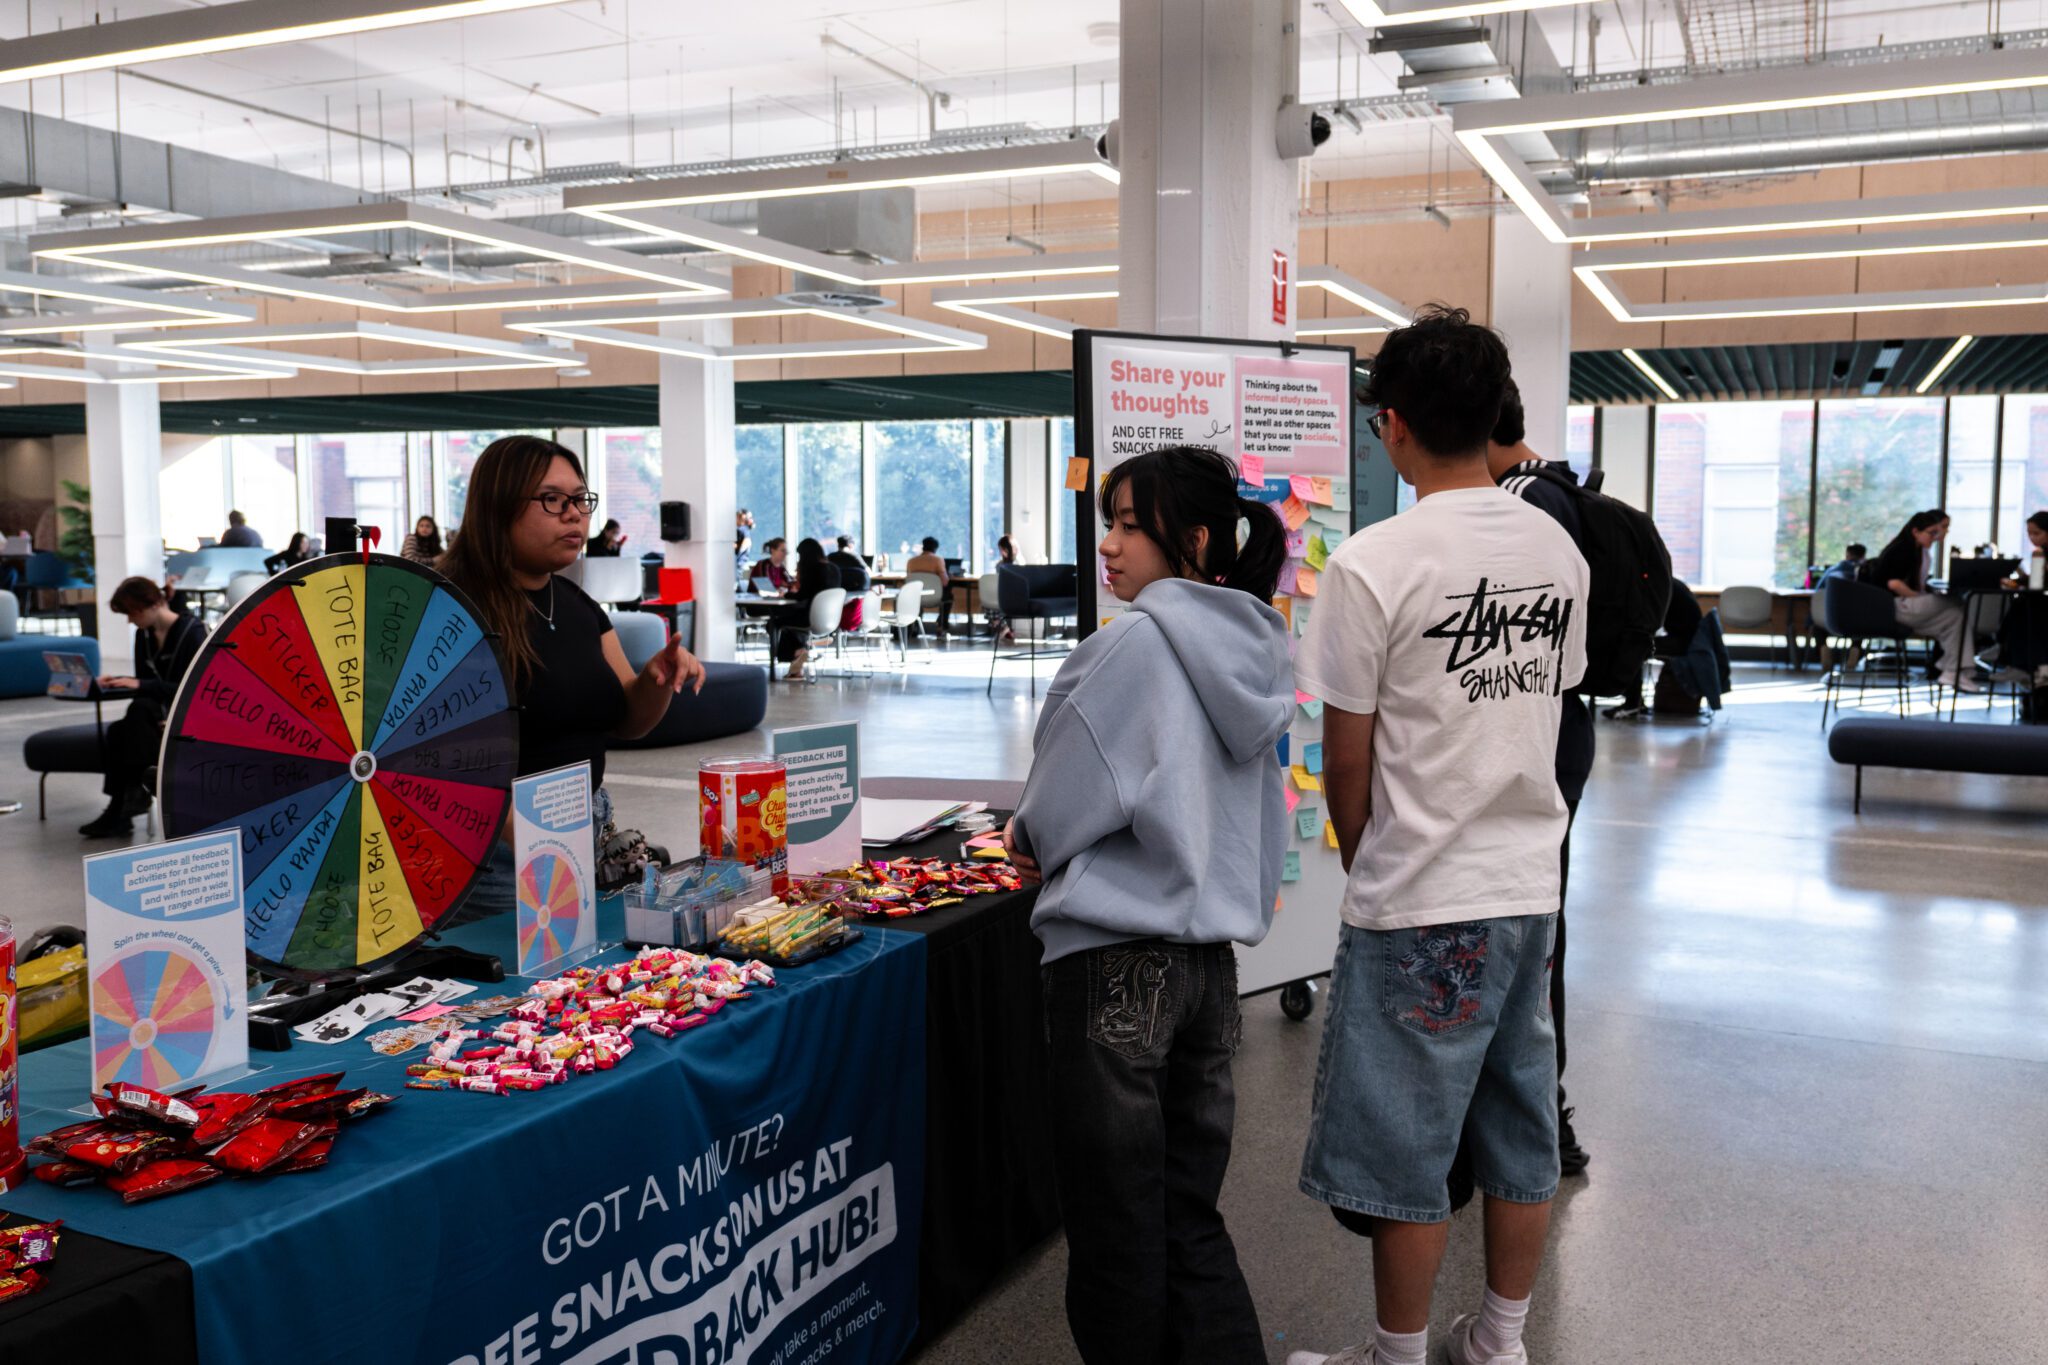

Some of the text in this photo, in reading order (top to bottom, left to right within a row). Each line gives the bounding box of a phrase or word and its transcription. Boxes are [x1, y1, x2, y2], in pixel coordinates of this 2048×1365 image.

[1110, 360, 1225, 391] Share your
[1245, 380, 1318, 392] Thinking about the
[1111, 390, 1209, 419] thoughts
[1245, 405, 1261, 414] that
[1263, 408, 1277, 416] you
[1255, 419, 1272, 427] well
[1284, 420, 1304, 428] other
[1306, 422, 1331, 430] spaces
[1112, 425, 1184, 440] AND GET FREE
[1112, 441, 1154, 454] SNACKS
[1244, 430, 1261, 438] that
[1244, 442, 1254, 451] let
[326, 576, 361, 704] TOTE BAG
[376, 585, 410, 667] CHOOSE
[252, 614, 328, 712] STICKER
[383, 613, 467, 729] HELLO PANDA
[1460, 656, 1550, 702] SHANGHA
[200, 673, 323, 754] HELLO PANDA
[415, 671, 492, 736] STICKER
[826, 750, 844, 759] HUB
[798, 776, 815, 785] each
[817, 772, 844, 783] activity
[800, 798, 812, 808] get
[820, 793, 841, 803] snack
[242, 802, 302, 854] CKER
[392, 774, 492, 839] HELLO PANDA
[809, 807, 828, 815] item.
[128, 872, 167, 887] activities
[169, 869, 181, 878] for
[190, 862, 219, 873] chance
[136, 847, 229, 872] Complete all feedback
[245, 809, 336, 940] HELLO PANDA
[389, 810, 454, 900] STICKER
[145, 895, 161, 905] and
[163, 892, 179, 901] win
[181, 888, 200, 897] from
[209, 881, 228, 890] wide
[168, 879, 186, 889] spin
[204, 869, 228, 880] wheel
[168, 899, 192, 911] range
[205, 890, 231, 904] prizes!
[365, 831, 396, 947] TOTE BAG
[312, 872, 344, 949] CHOOSE
[114, 930, 224, 977] Spin the wheel and get a prize!
[542, 1112, 784, 1265] GOT A MINUTE?
[550, 1216, 729, 1349] SNACKS
[728, 1184, 764, 1248] ON
[767, 1160, 806, 1216] US
[812, 1136, 852, 1194] AT
[790, 1185, 880, 1292] HUB!
[784, 1329, 808, 1358] take
[811, 1320, 818, 1336] a
[820, 1281, 870, 1328] moment.
[835, 1327, 843, 1346] &
[845, 1300, 886, 1338] merch.
